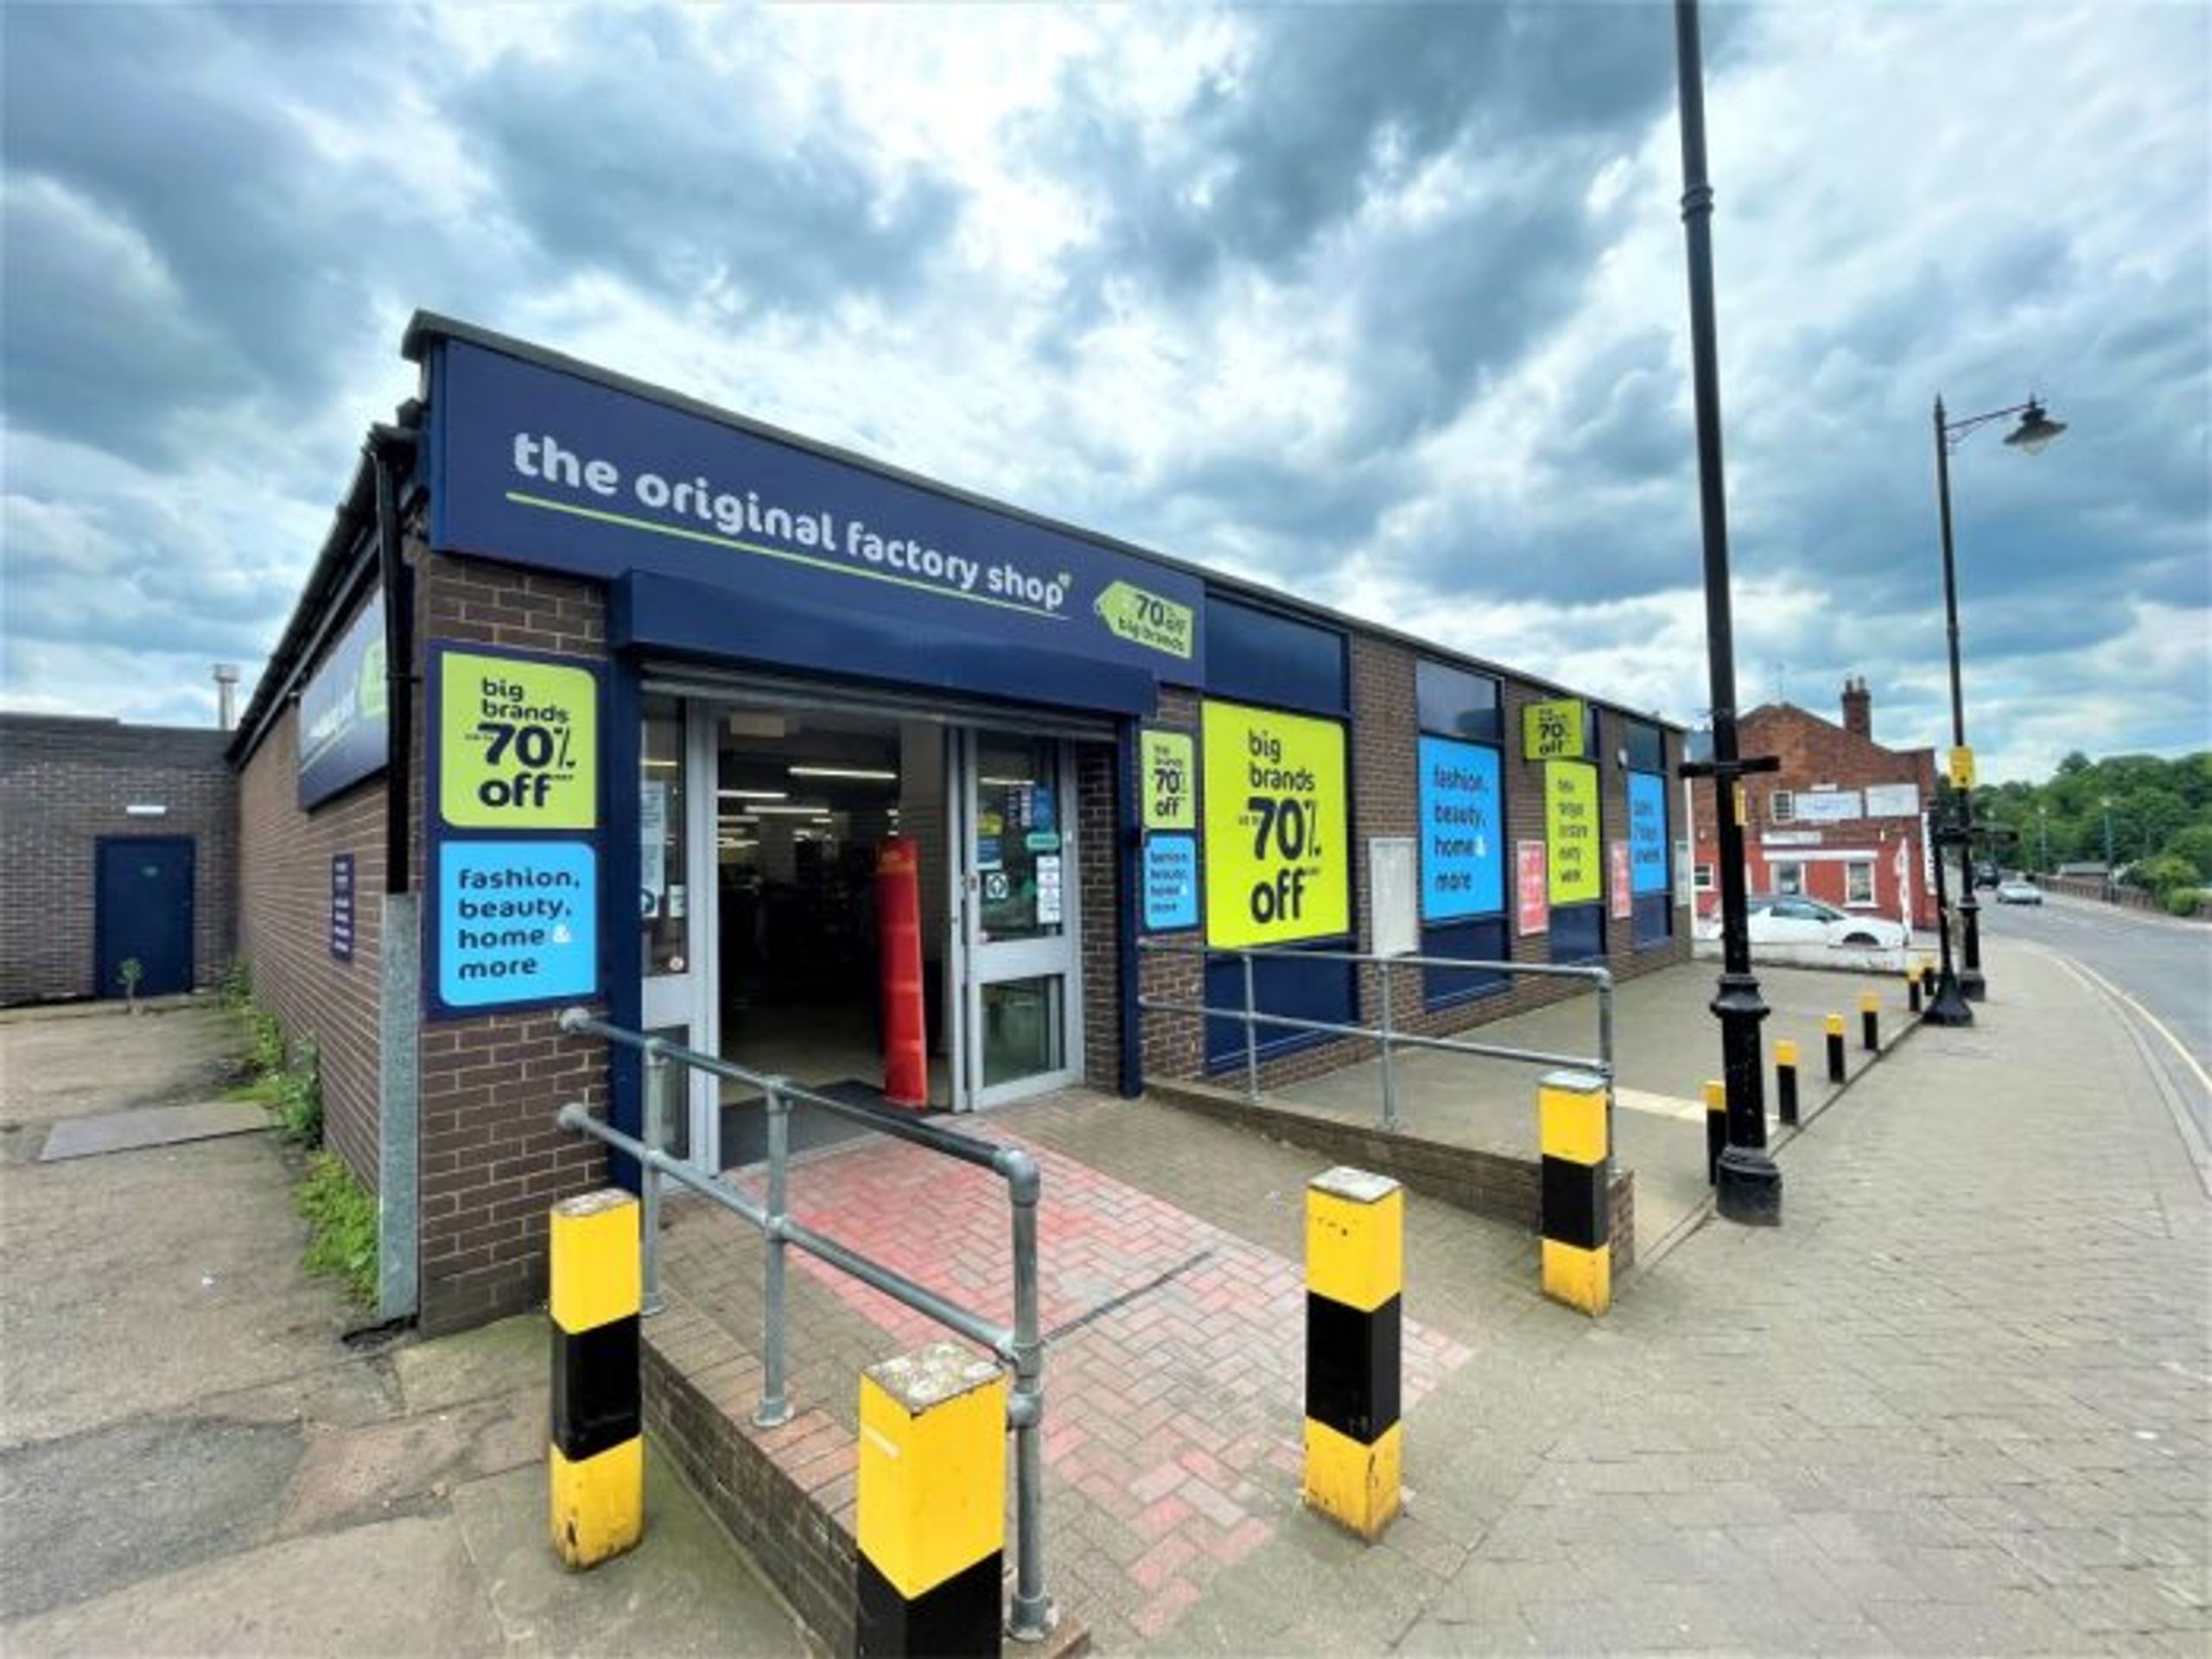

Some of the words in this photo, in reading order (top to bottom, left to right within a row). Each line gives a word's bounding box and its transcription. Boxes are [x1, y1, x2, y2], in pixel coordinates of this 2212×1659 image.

[513, 431, 620, 495] the
[634, 473, 836, 552] original
[846, 521, 979, 589] factory
[988, 564, 1065, 608] shop
[482, 677, 524, 702] big
[482, 699, 570, 724] brands
[1249, 728, 1281, 764] big
[1249, 760, 1317, 792] brands
[479, 772, 550, 808] off
[1154, 796, 1180, 817] off
[459, 867, 581, 889] fashion,
[1251, 867, 1306, 925] off
[459, 898, 573, 920] beauty,
[459, 928, 546, 950] home
[458, 957, 538, 980] more
